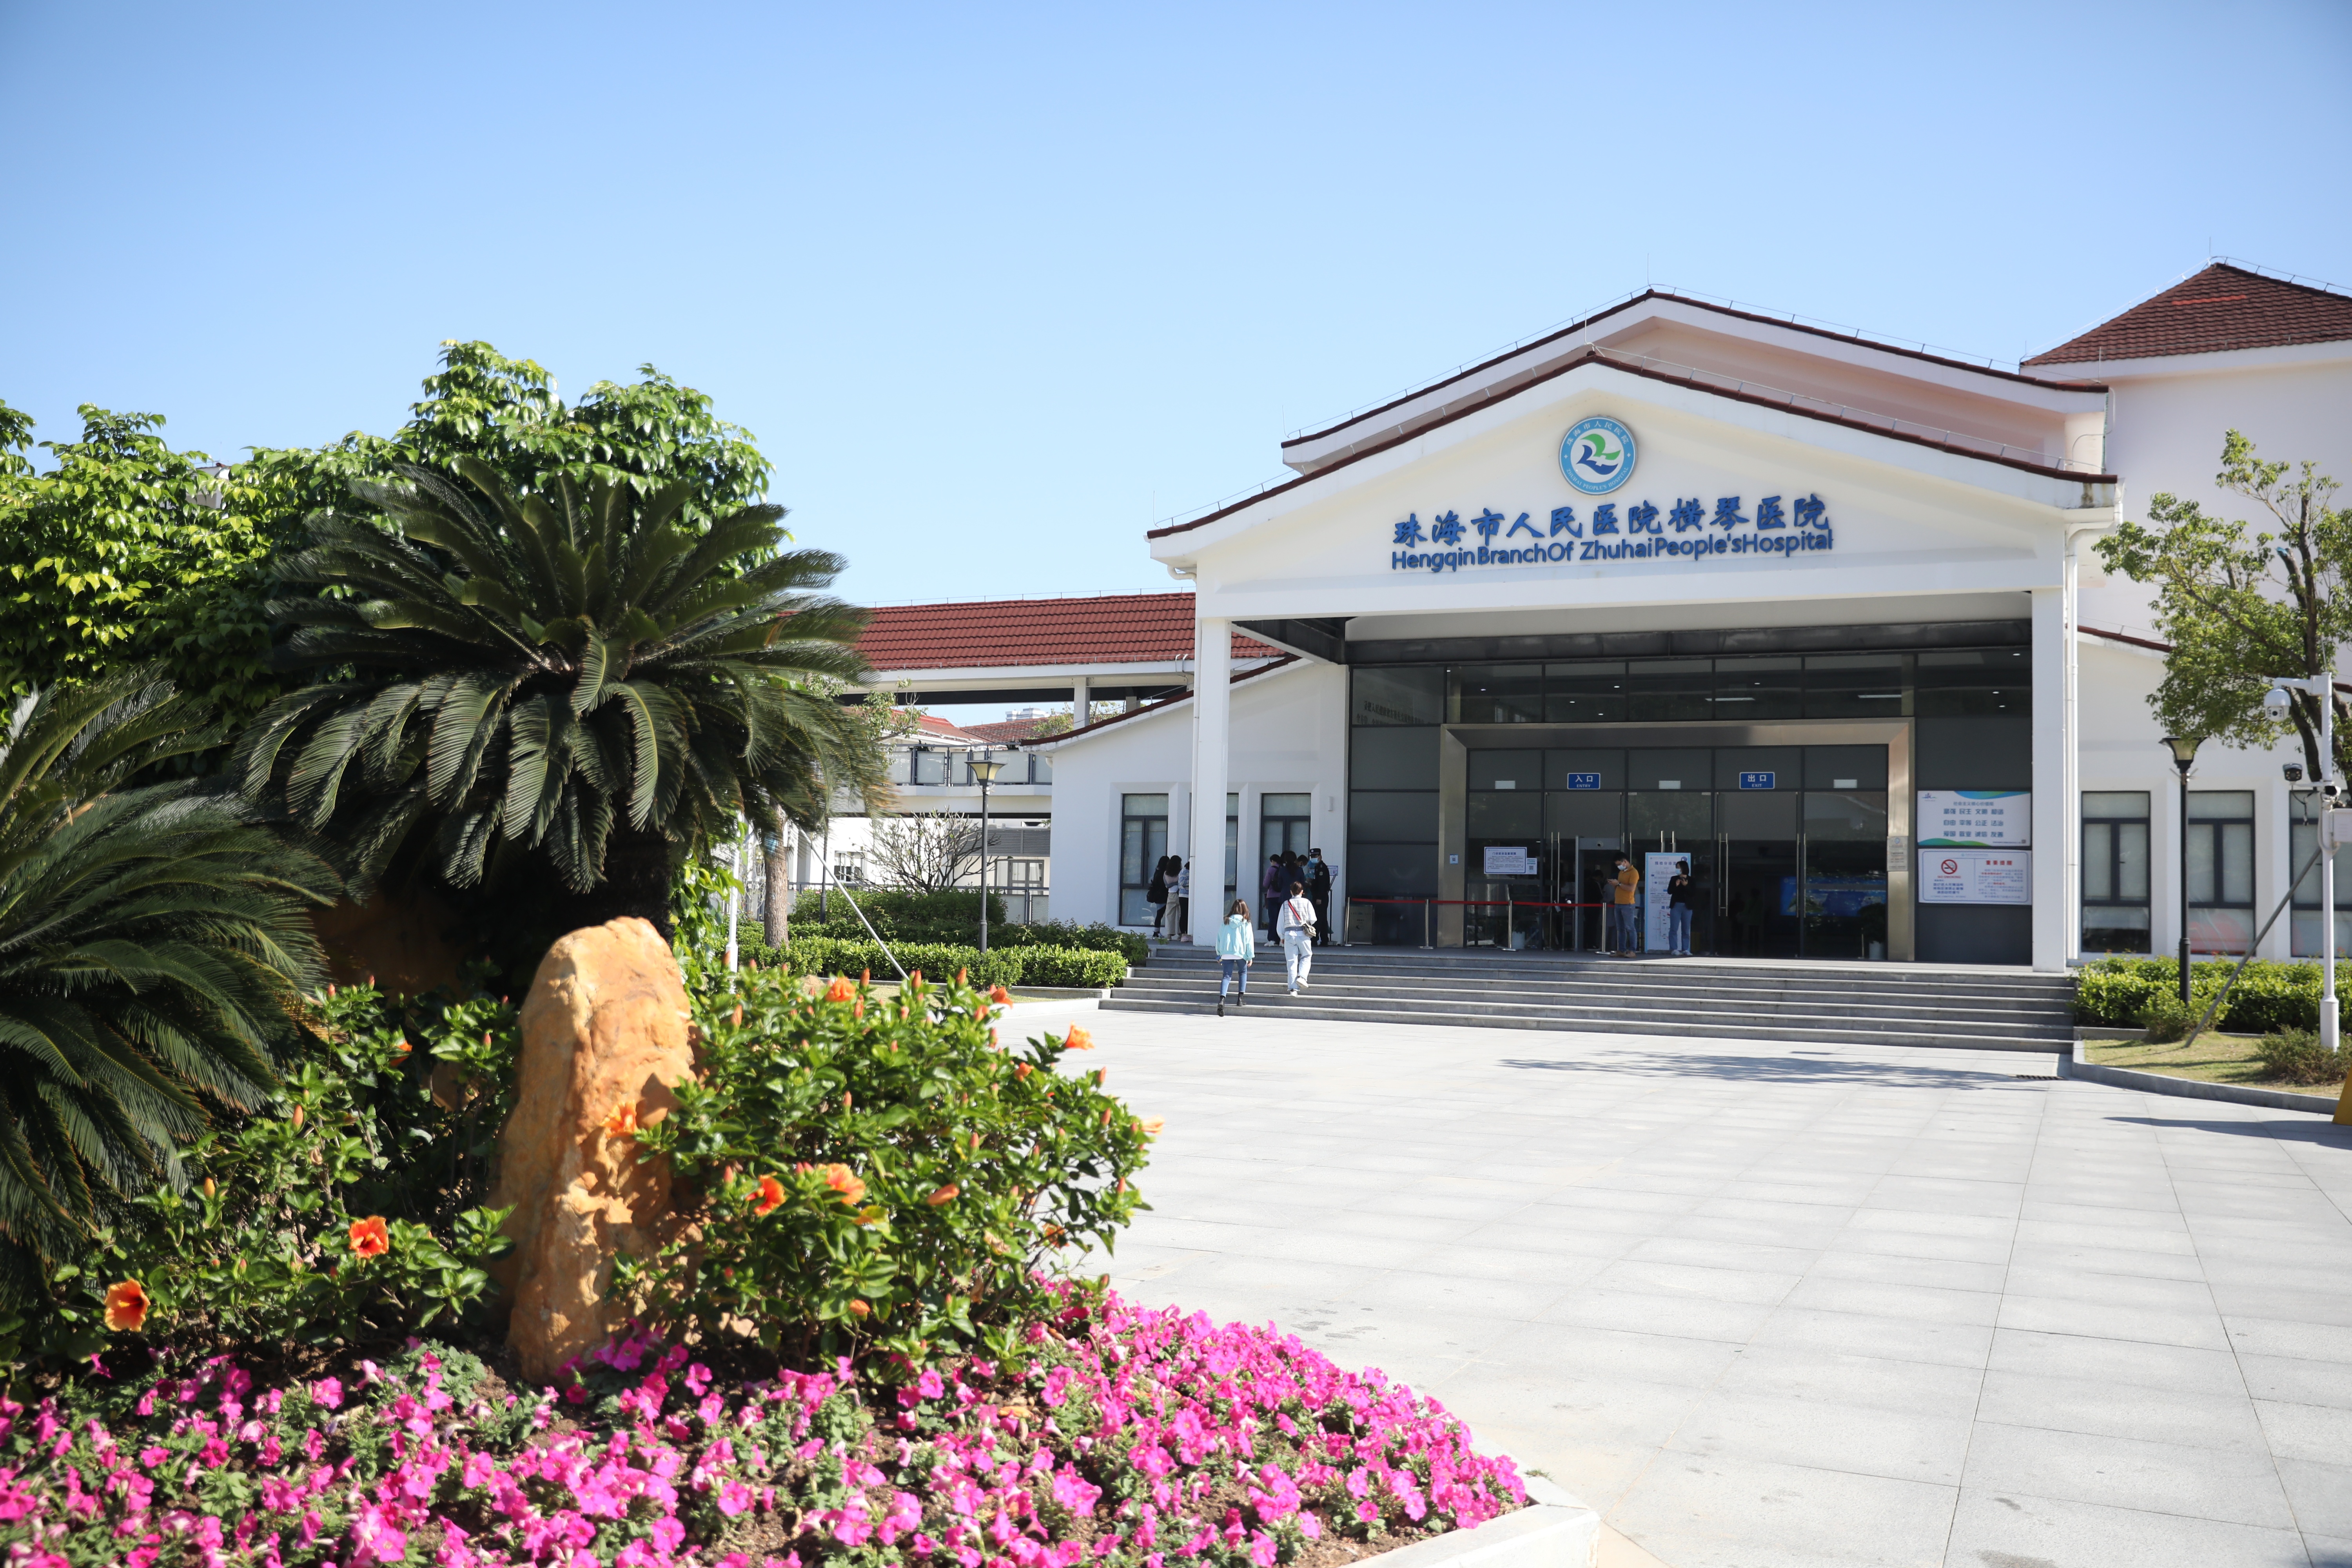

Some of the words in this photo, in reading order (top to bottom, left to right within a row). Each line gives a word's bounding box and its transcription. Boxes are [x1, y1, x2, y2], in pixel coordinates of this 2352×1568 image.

[1566, 421, 1629, 445] 珠海市人民医院
[1566, 468, 1581, 485] ZHUHAI
[1608, 467, 1628, 487] HOSPITAL
[1393, 494, 1829, 548] 珠海市人民医院横琴医院
